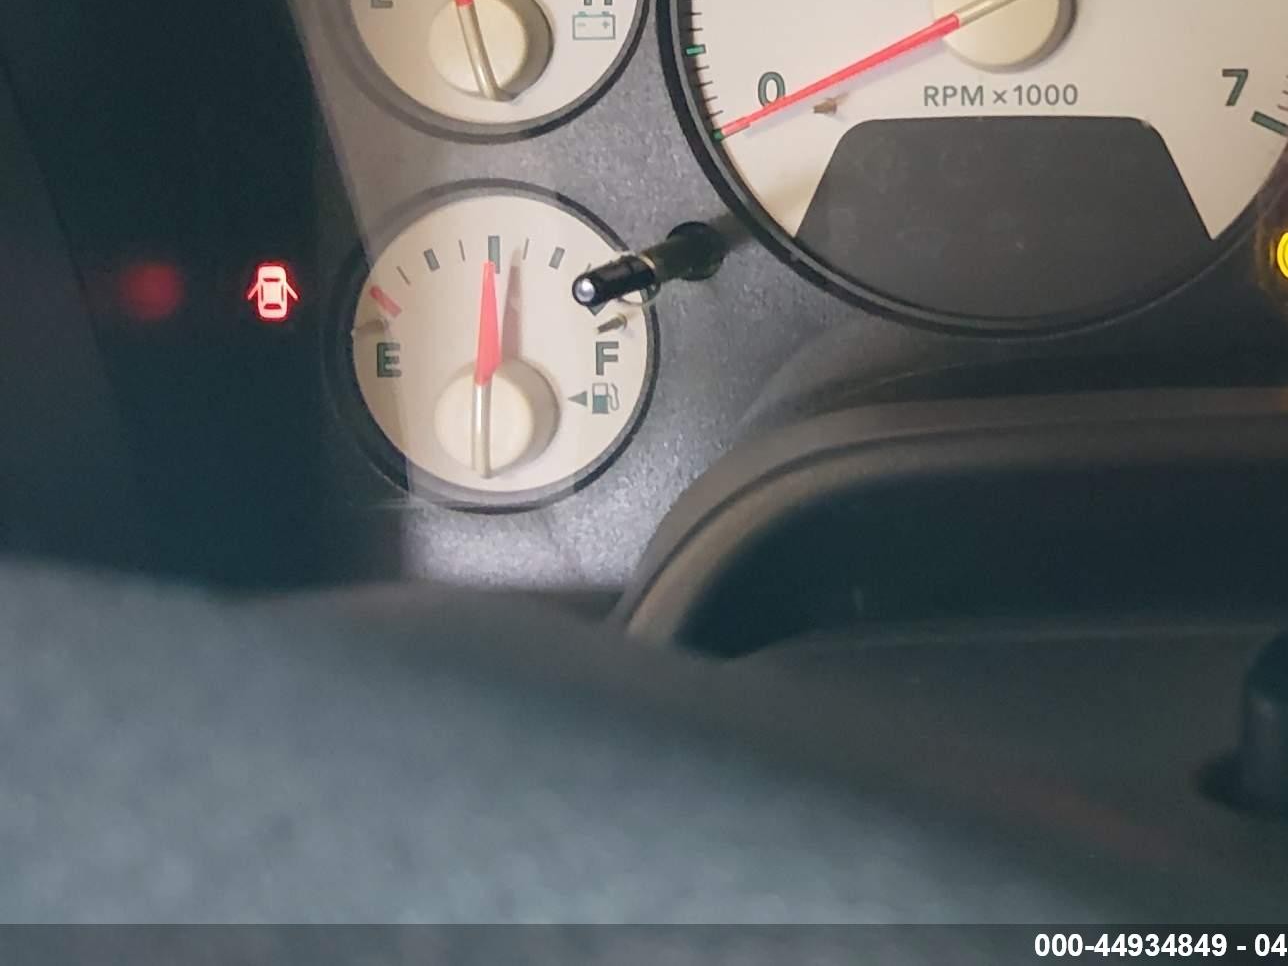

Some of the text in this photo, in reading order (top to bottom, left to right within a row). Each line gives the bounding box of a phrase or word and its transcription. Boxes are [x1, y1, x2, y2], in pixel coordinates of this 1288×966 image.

[757, 71, 786, 107] 0
[924, 85, 985, 107] RPM
[1222, 68, 1249, 106] 7
[378, 343, 401, 377] E
[596, 341, 619, 375] F
